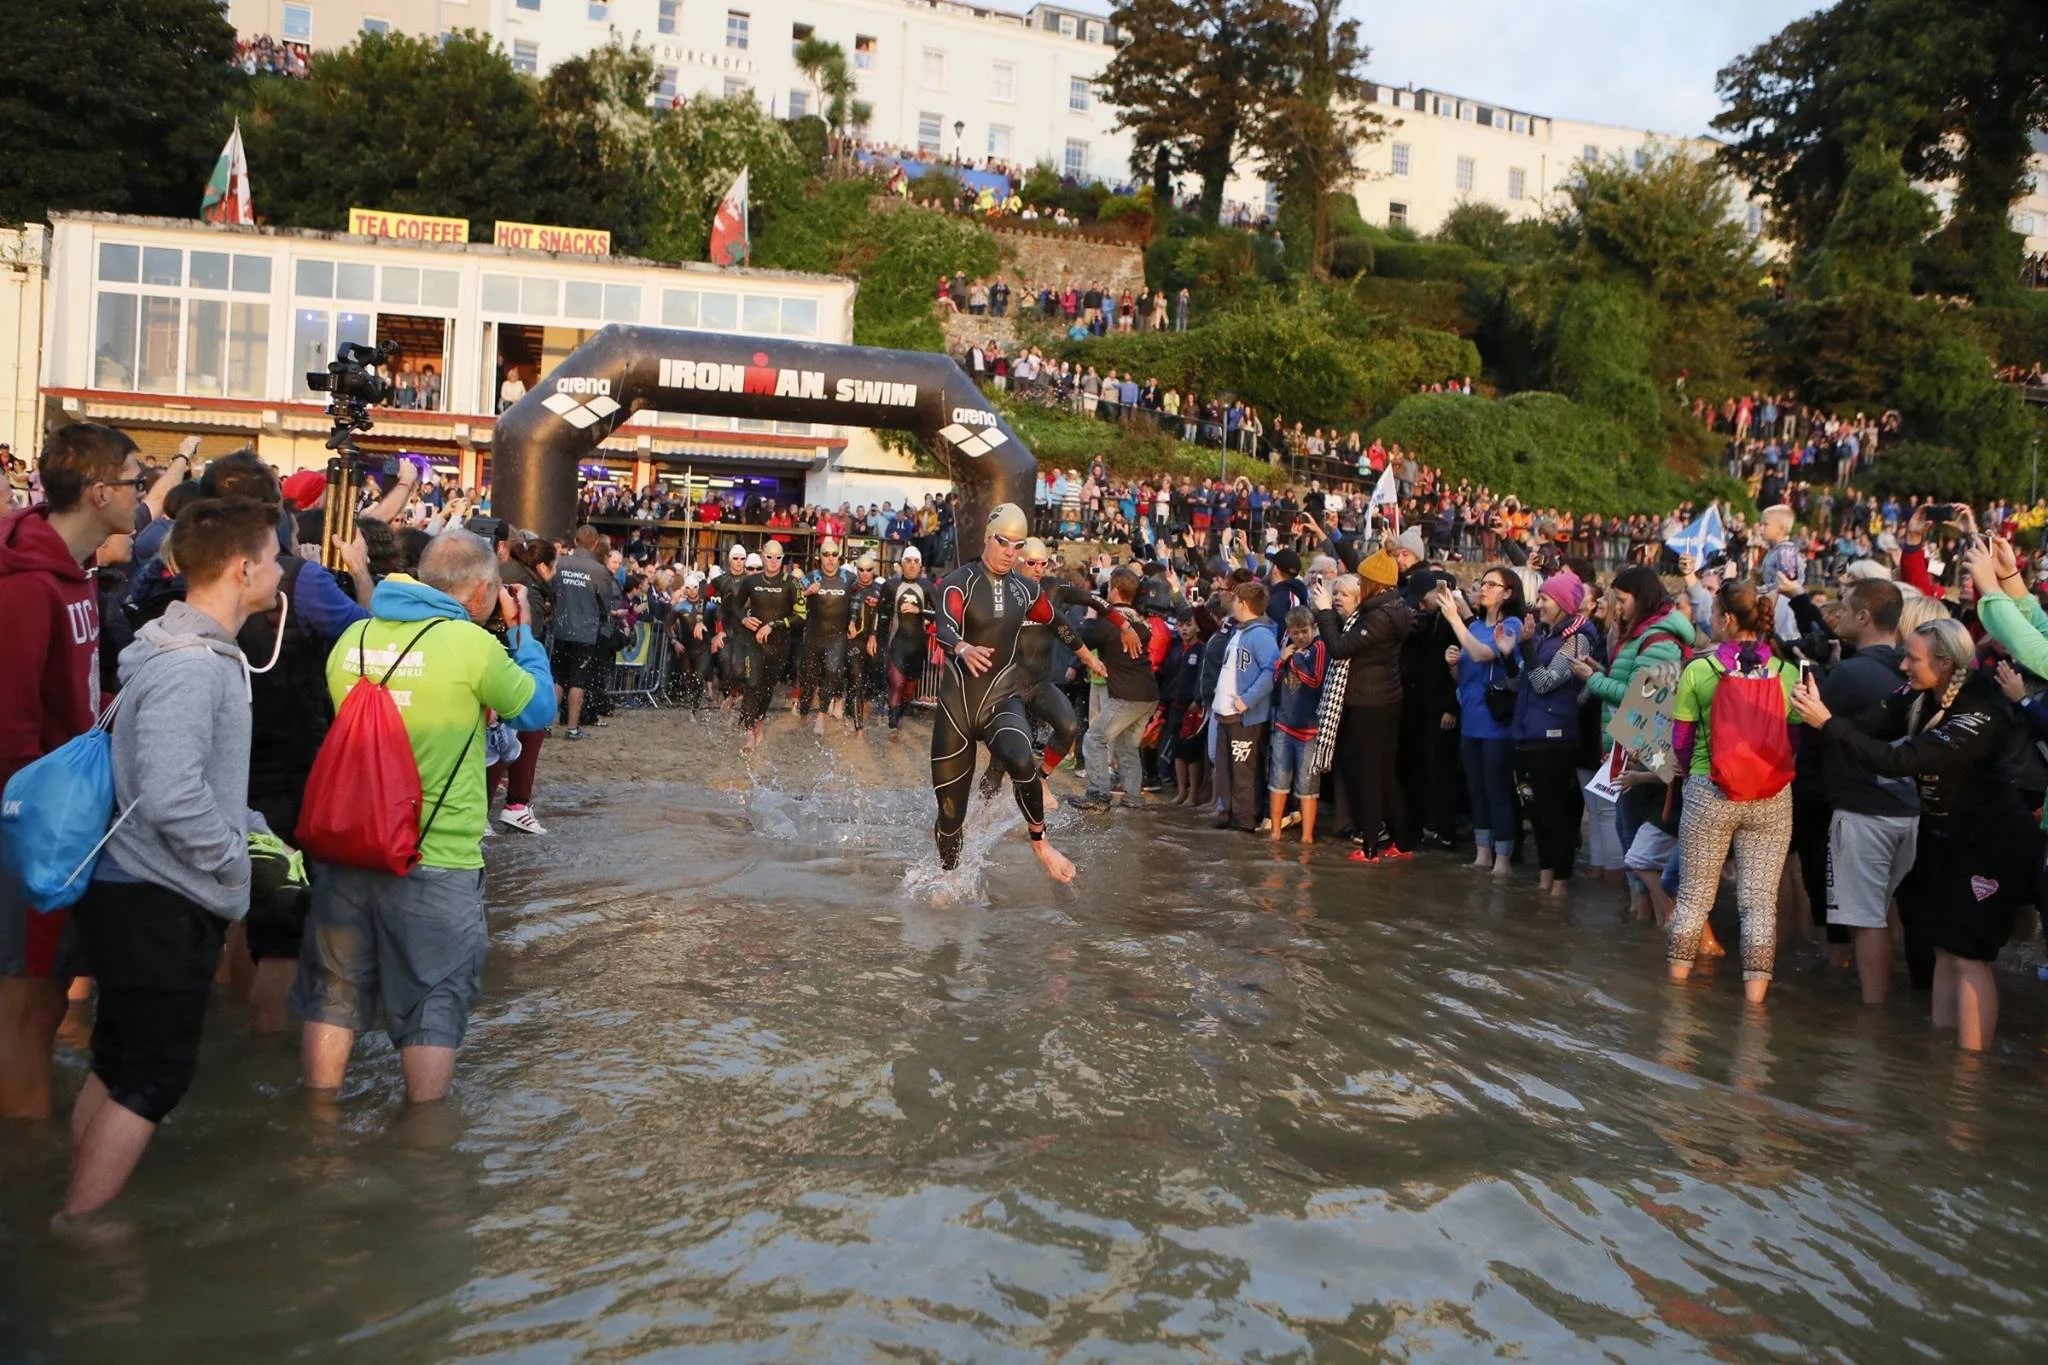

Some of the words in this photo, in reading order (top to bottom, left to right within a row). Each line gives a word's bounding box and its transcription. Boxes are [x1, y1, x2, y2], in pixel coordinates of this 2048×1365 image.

[356, 214, 389, 237] TEA
[396, 218, 462, 243] COFFEE
[498, 225, 533, 249] HOT
[539, 229, 607, 256] SNACKS
[557, 377, 611, 396] arena
[658, 352, 825, 399] IRONMAN
[835, 378, 917, 407] SWIM
[952, 407, 998, 427] arena
